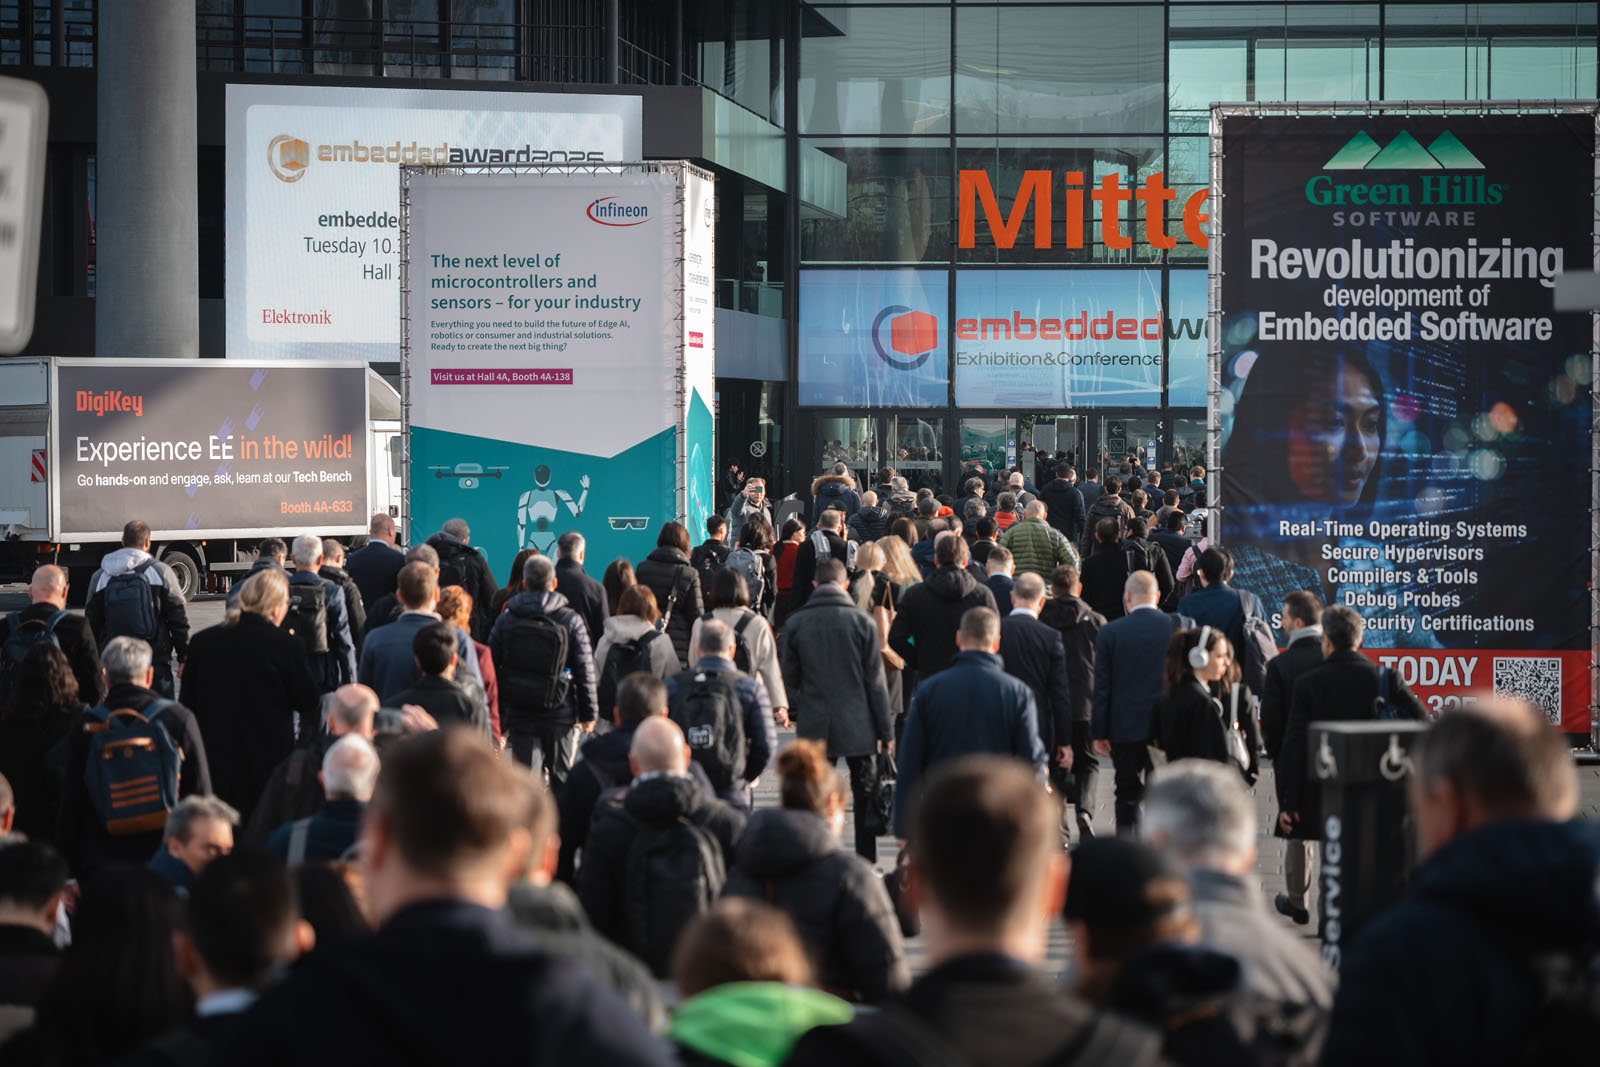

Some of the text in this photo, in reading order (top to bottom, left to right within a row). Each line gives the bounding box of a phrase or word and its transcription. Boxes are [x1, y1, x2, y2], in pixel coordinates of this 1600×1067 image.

[1305, 175, 1411, 206] Green
[319, 212, 400, 228] embedde
[1333, 211, 1476, 227] SOFTWARE
[304, 237, 366, 258] Tuesday
[431, 253, 560, 268] The next level of
[1251, 238, 1563, 288] Revolutionizing
[364, 264, 391, 280] Hall
[432, 274, 596, 288] microcontrollers and
[432, 297, 491, 309] sensors
[508, 295, 530, 309] for
[535, 299, 571, 312] your
[575, 295, 641, 312] industry
[1324, 284, 1490, 310] development of
[263, 309, 331, 324] Elektronik
[431, 320, 474, 329] Everything
[493, 320, 512, 329] need
[514, 321, 522, 329] to
[525, 320, 544, 329] build
[547, 320, 560, 329] the
[562, 320, 586, 329] future
[588, 320, 596, 329] of
[598, 320, 617, 329] Edge
[619, 320, 630, 328] AI,
[1259, 311, 1552, 341] Embedded Software
[431, 331, 463, 339] robotics
[517, 331, 532, 339] and
[534, 331, 572, 339] industrial
[574, 331, 613, 339] solutions.
[431, 343, 455, 352] Ready
[528, 343, 540, 352] big
[543, 343, 567, 352] thing?
[957, 351, 1162, 366] Exhibition&Conference
[432, 372, 453, 382] Visit
[467, 373, 475, 381] at
[476, 372, 494, 382] Hall
[495, 373, 510, 382] 4A,
[511, 372, 538, 382] Booth
[539, 372, 571, 382] 4A-138
[76, 391, 142, 416] DigiKey
[77, 435, 353, 467] Experience EE in the wild!
[78, 471, 351, 487] Go hands-on and engage, ask, learn at our Tech Bench
[281, 500, 352, 513] Booth 4A-633
[1280, 521, 1527, 541] Real-Time Operating Systems
[1322, 545, 1483, 562] Secure Hypervisors
[1328, 568, 1478, 586] Compilers & Tools
[1346, 592, 1460, 609] Debug Probes
[1361, 614, 1534, 633] ecurity Certifications
